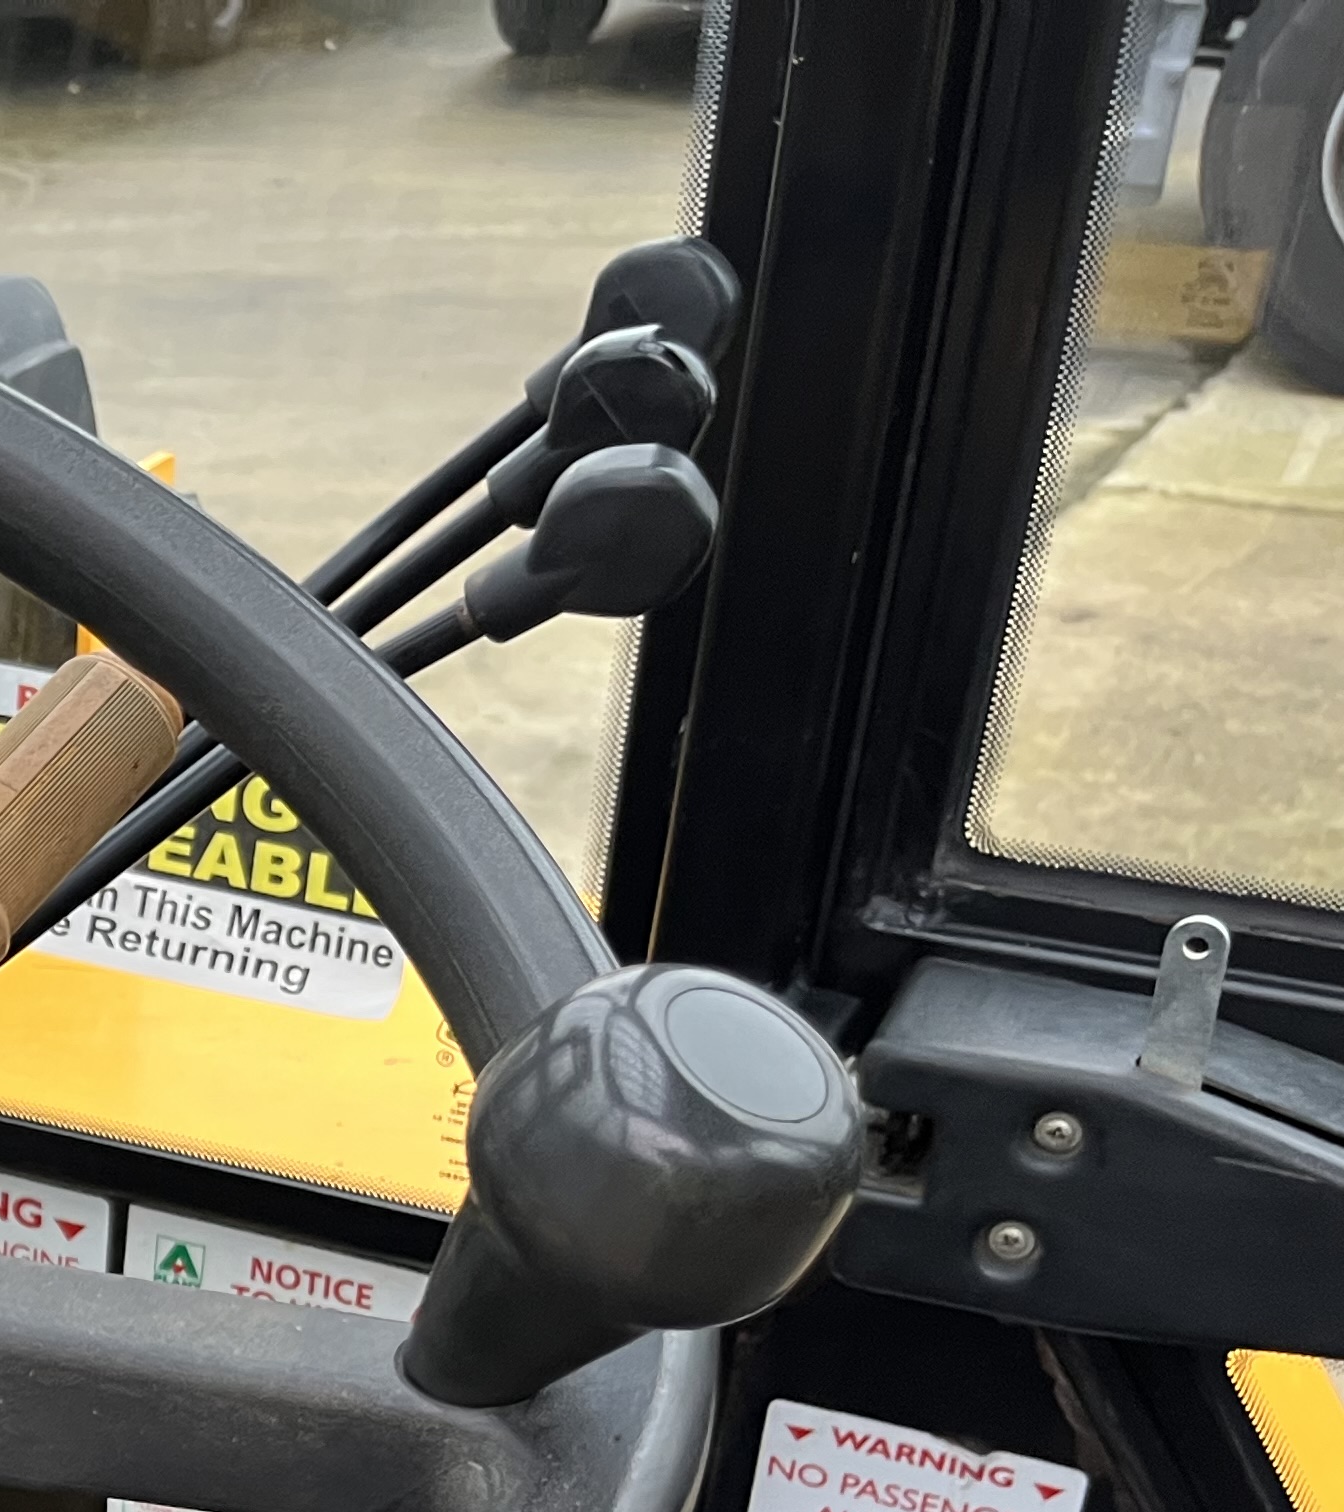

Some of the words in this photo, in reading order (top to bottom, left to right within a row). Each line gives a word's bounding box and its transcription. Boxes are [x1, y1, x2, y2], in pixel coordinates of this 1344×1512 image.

[86, 914, 311, 995] Returning
[134, 884, 213, 931] This
[227, 904, 394, 968] Machine
[250, 1256, 374, 1310] NOTICE
[768, 1455, 828, 1488] NO
[832, 1426, 1016, 1488] WARNING
